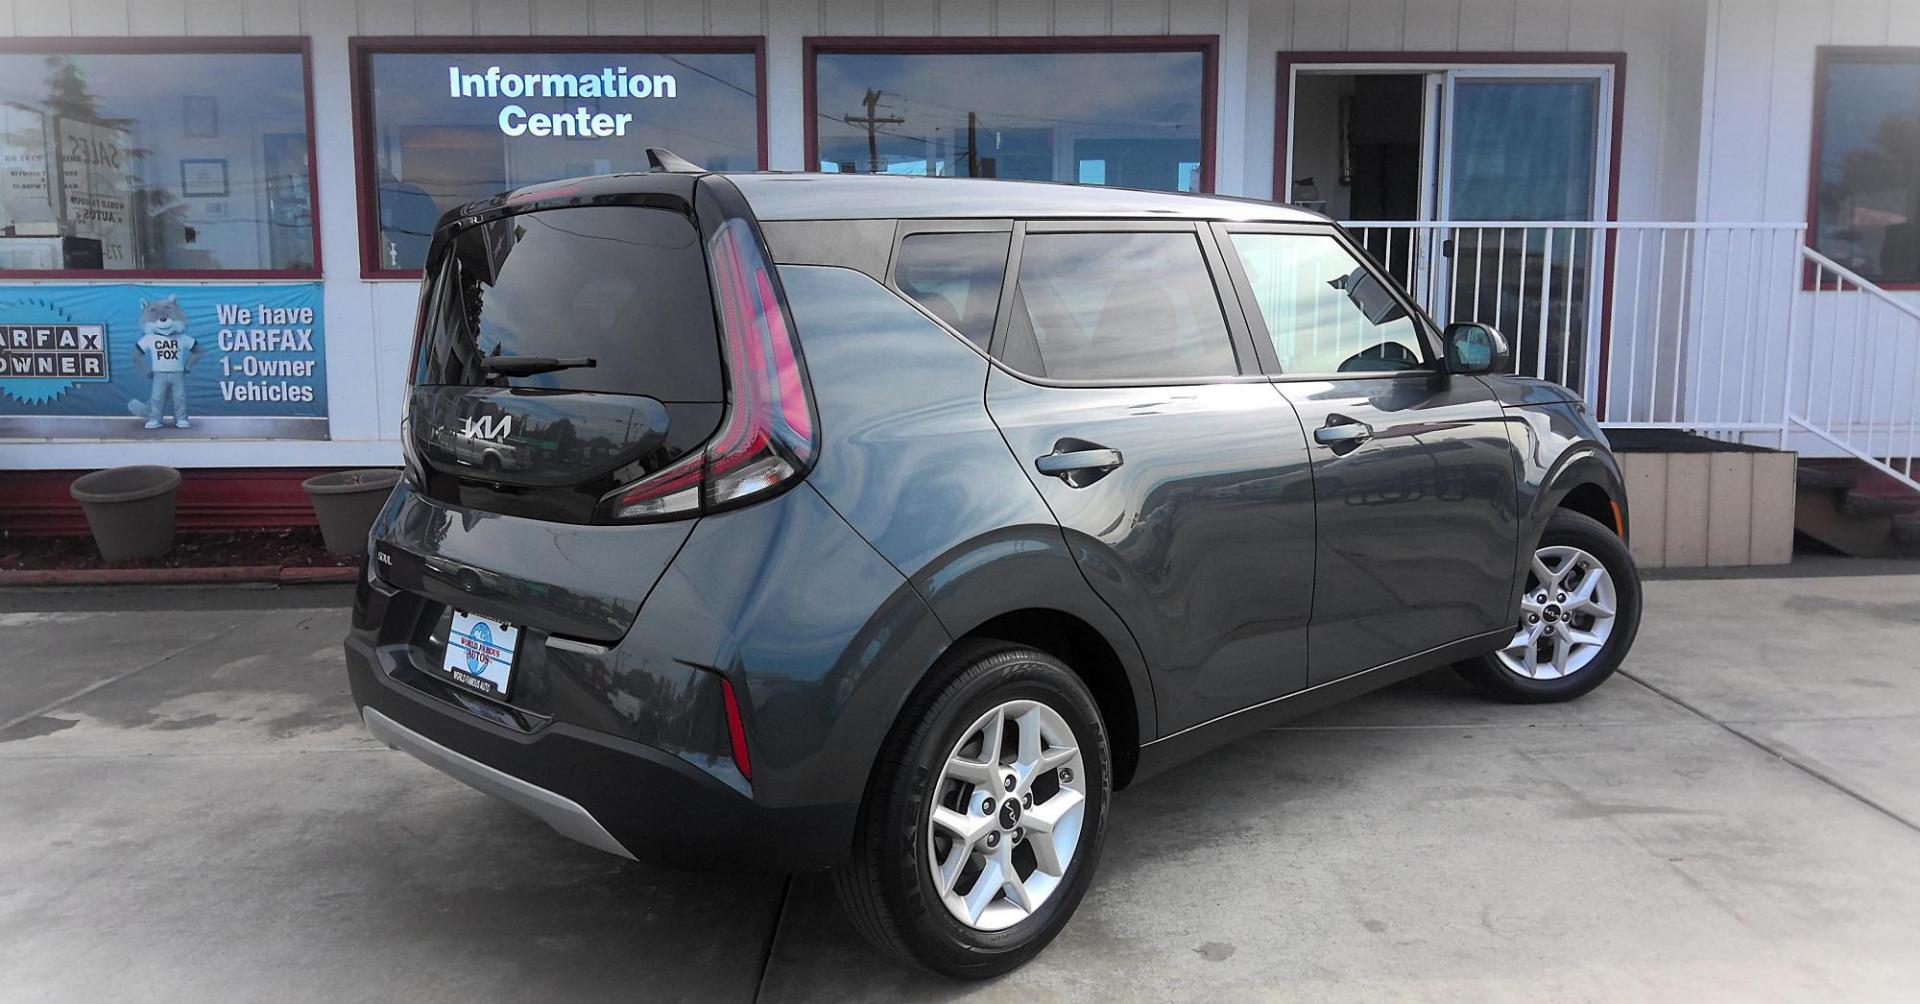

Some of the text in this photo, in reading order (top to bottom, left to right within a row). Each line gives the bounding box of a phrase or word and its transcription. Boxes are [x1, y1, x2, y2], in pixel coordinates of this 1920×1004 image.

[450, 66, 677, 98] Information
[499, 105, 632, 137] Center
[216, 304, 313, 325] We have
[154, 340, 179, 350] CAR
[218, 329, 314, 352] CARFAX
[157, 350, 179, 361] FOX
[219, 356, 316, 377] 1-Owner
[219, 381, 314, 402] Vehicles
[465, 415, 512, 439] KIA
[460, 637, 500, 658] WORLD FAMOUS
[467, 648, 490, 664] AUTOS
[453, 670, 465, 683] WORLD
[480, 680, 491, 693] AUTO
